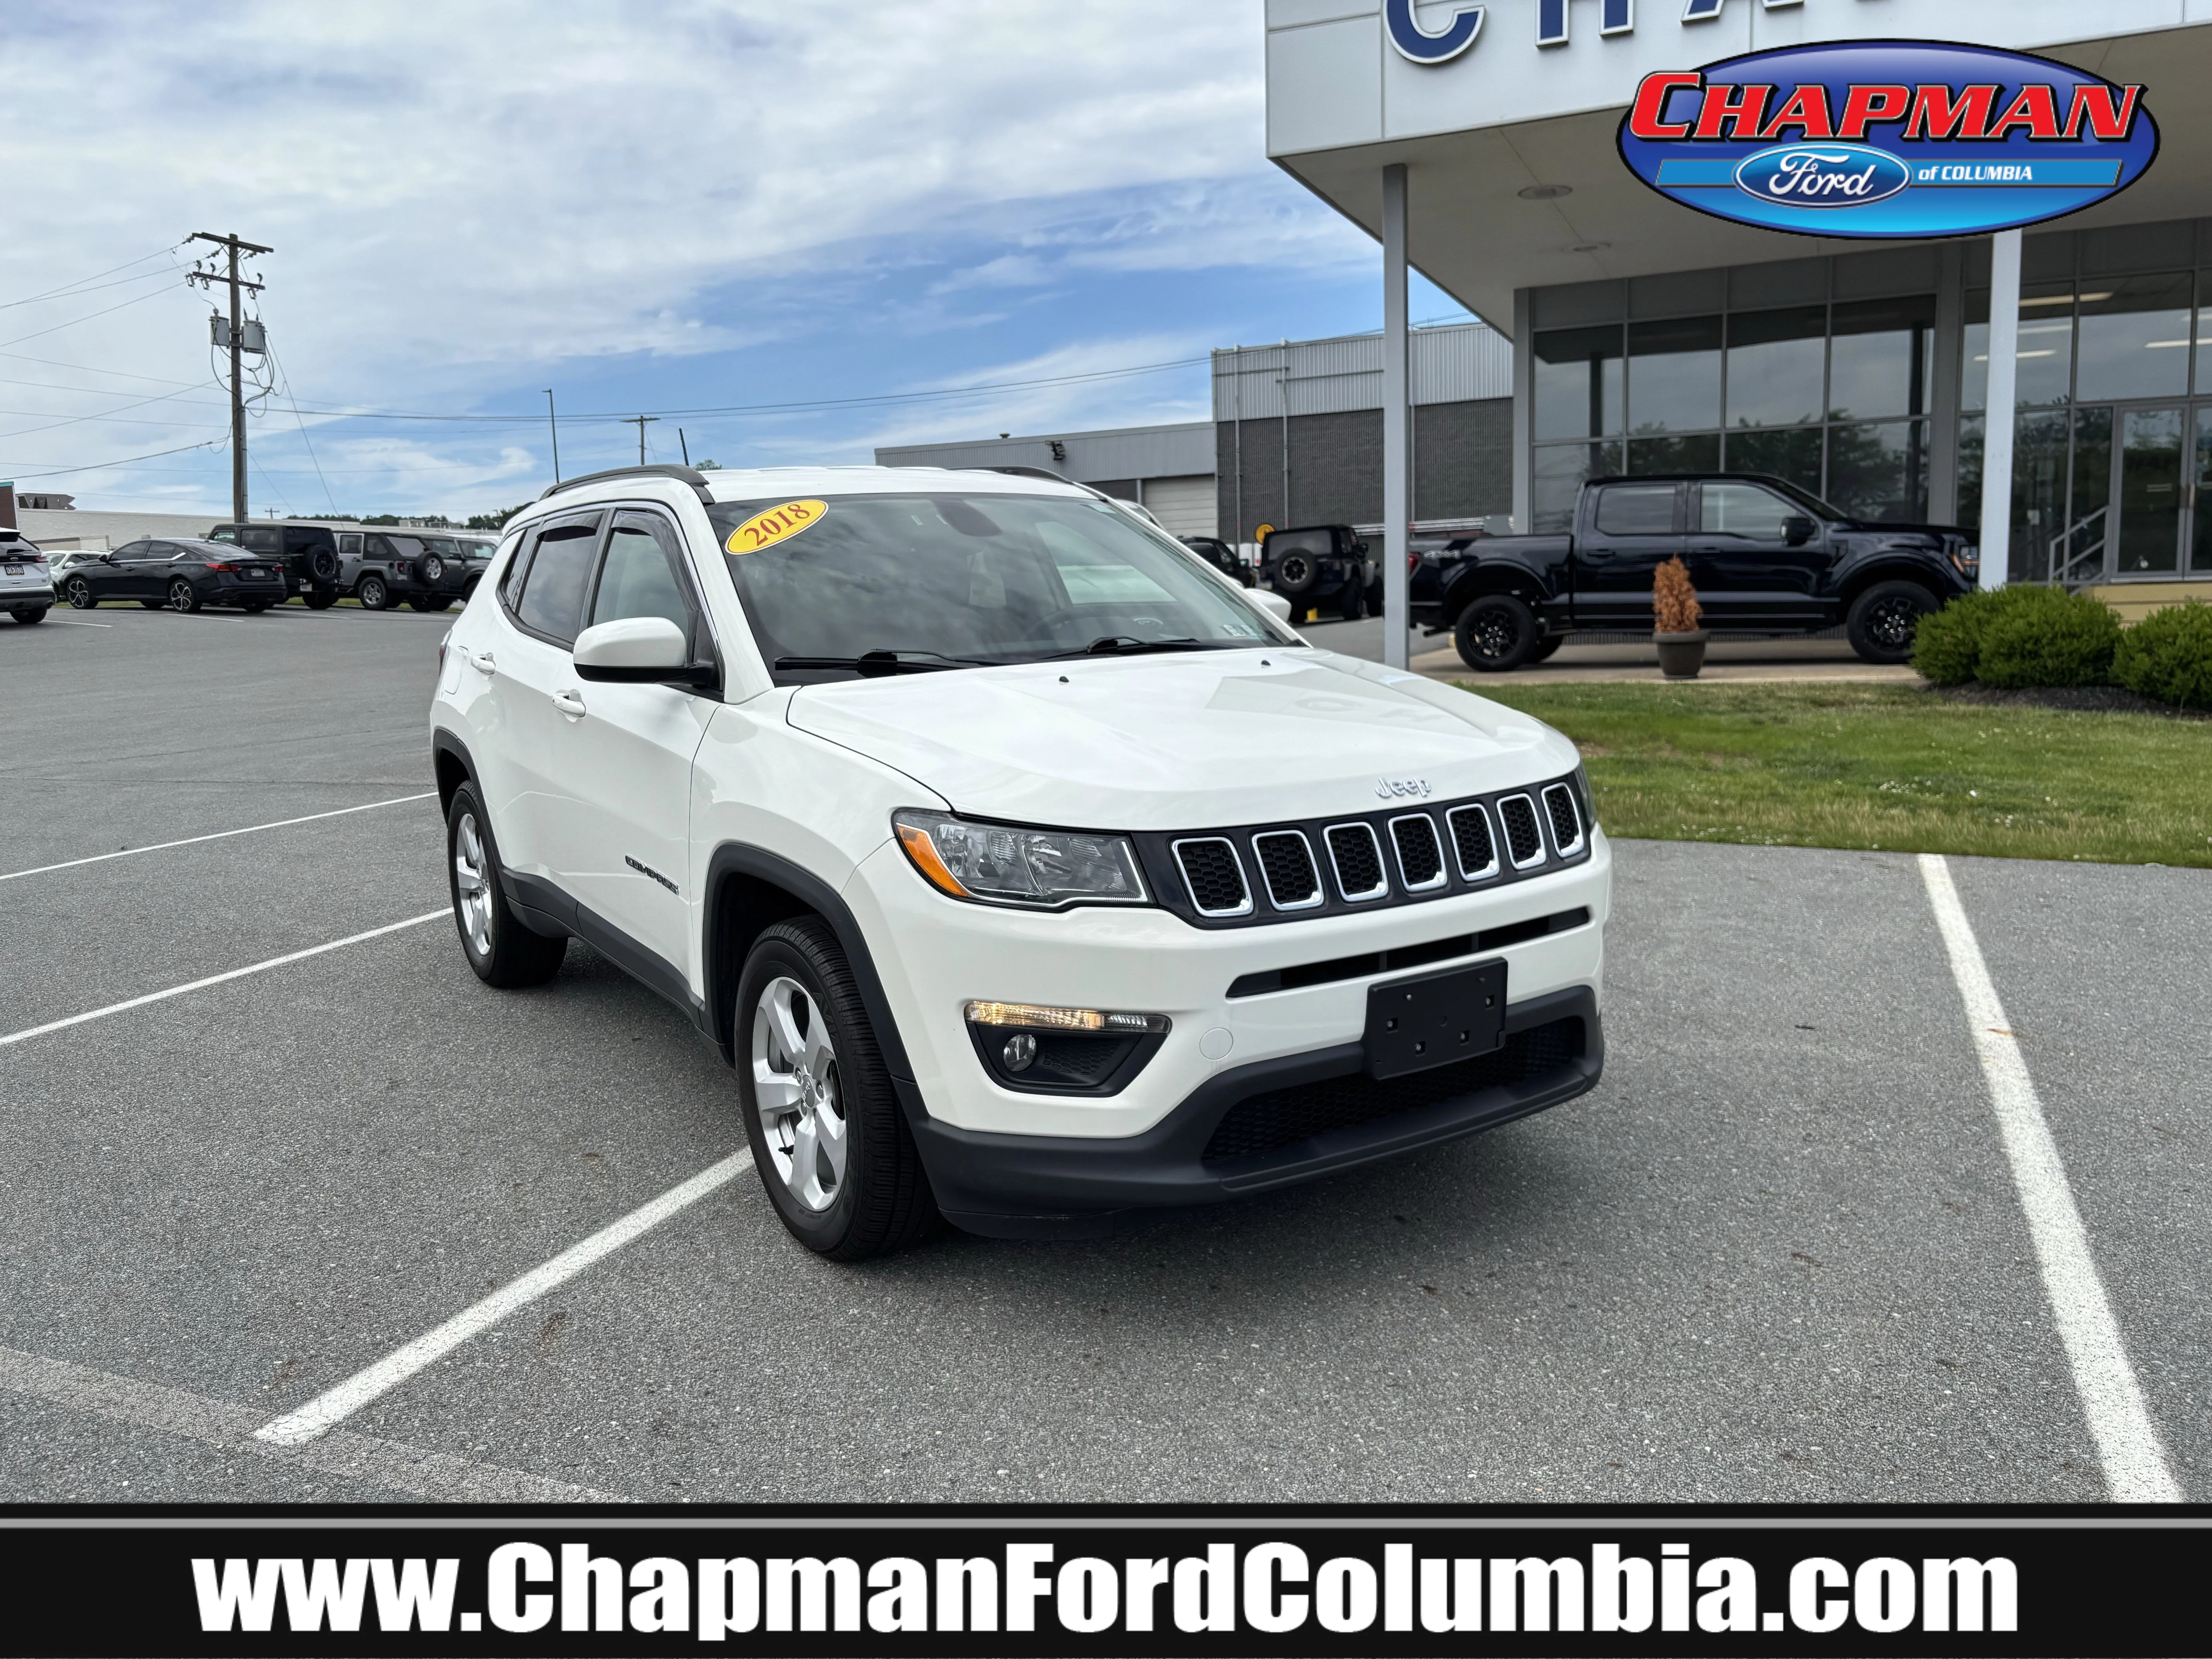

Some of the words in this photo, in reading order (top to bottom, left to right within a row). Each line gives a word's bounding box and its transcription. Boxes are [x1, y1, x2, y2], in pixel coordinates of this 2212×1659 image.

[744, 504, 810, 546] 2018
[1375, 777, 1432, 799] Jeep
[625, 854, 679, 896] COMPASS
